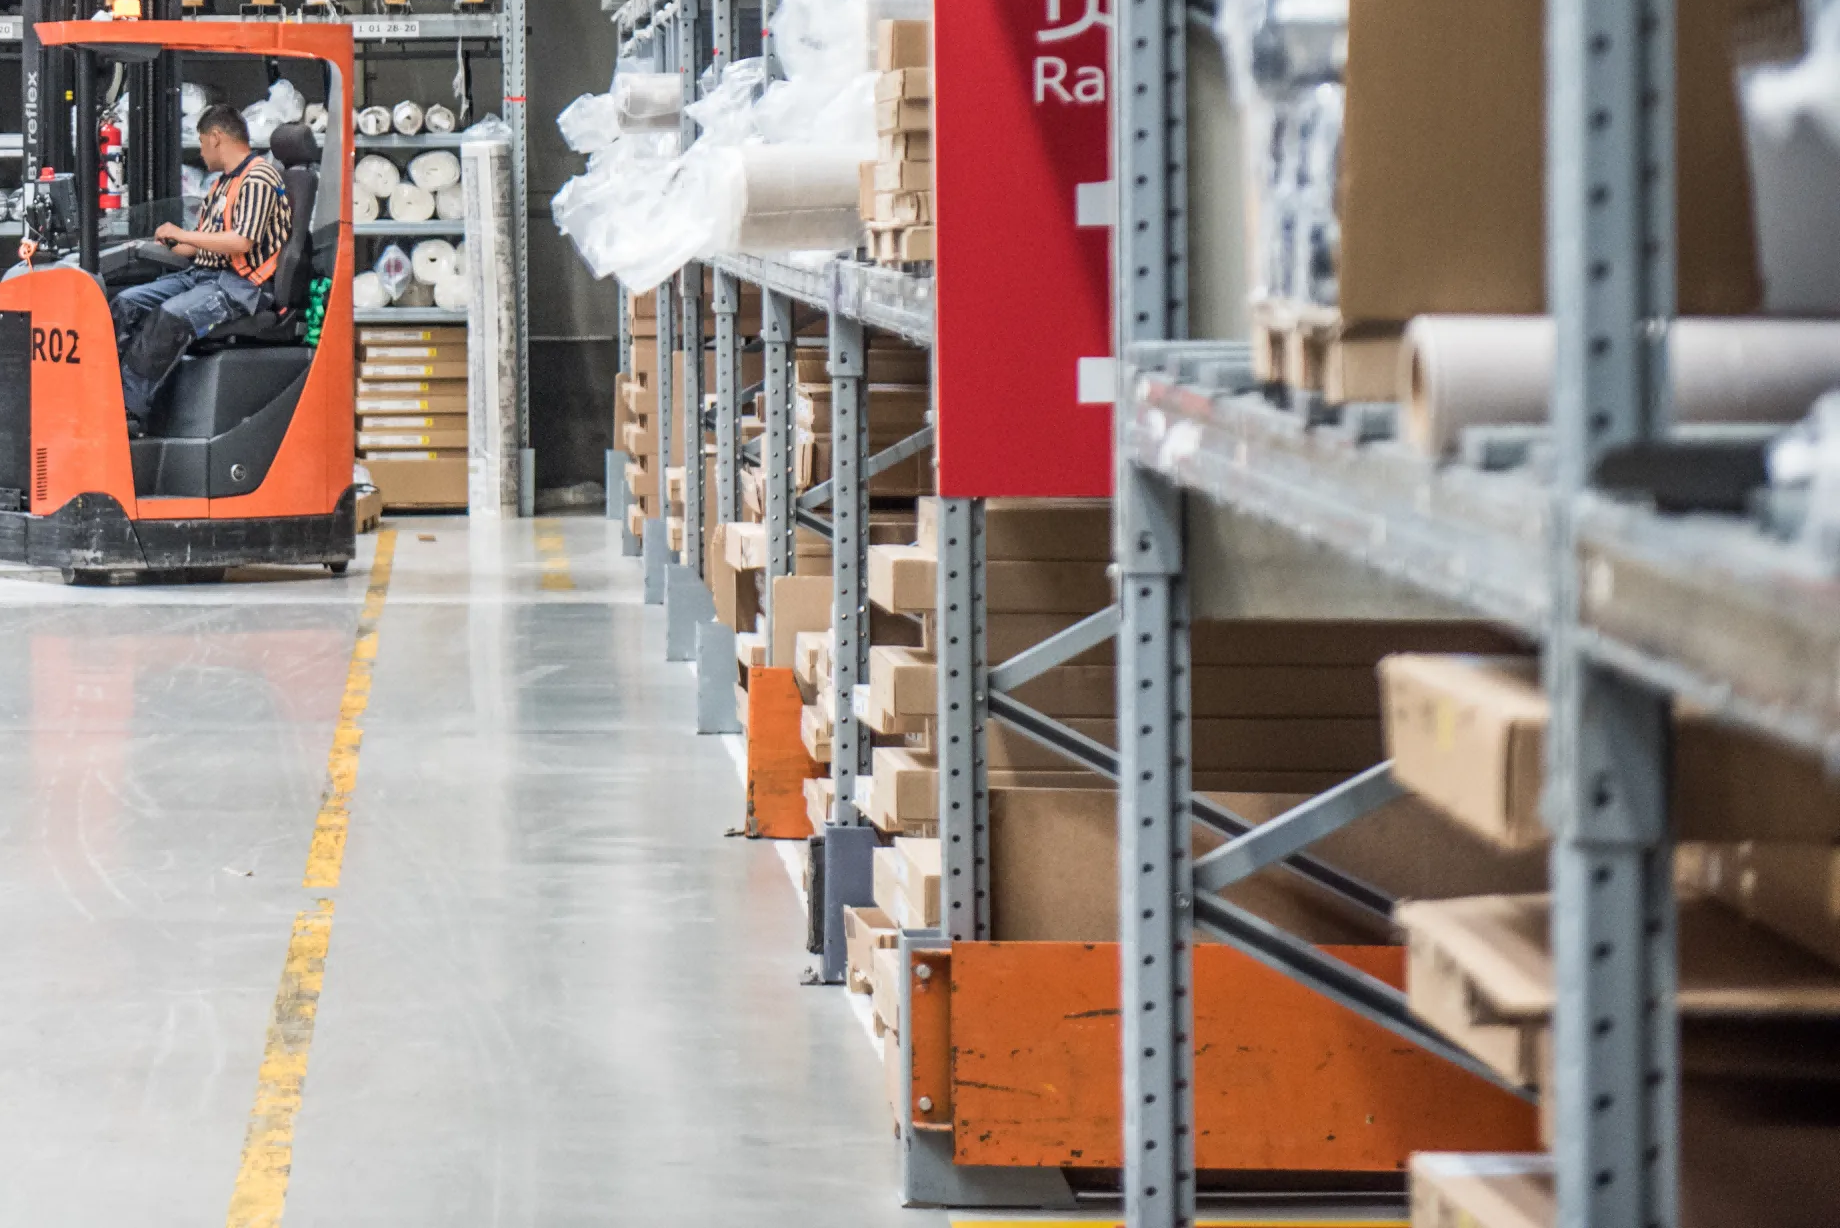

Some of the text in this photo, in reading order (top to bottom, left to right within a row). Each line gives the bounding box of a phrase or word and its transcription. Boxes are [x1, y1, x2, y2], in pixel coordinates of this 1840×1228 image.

[369, 23, 417, 32] 01-28-20
[1032, 55, 1107, 104] Ra
[25, 71, 38, 181] BT reflex
[32, 327, 81, 364] R02
